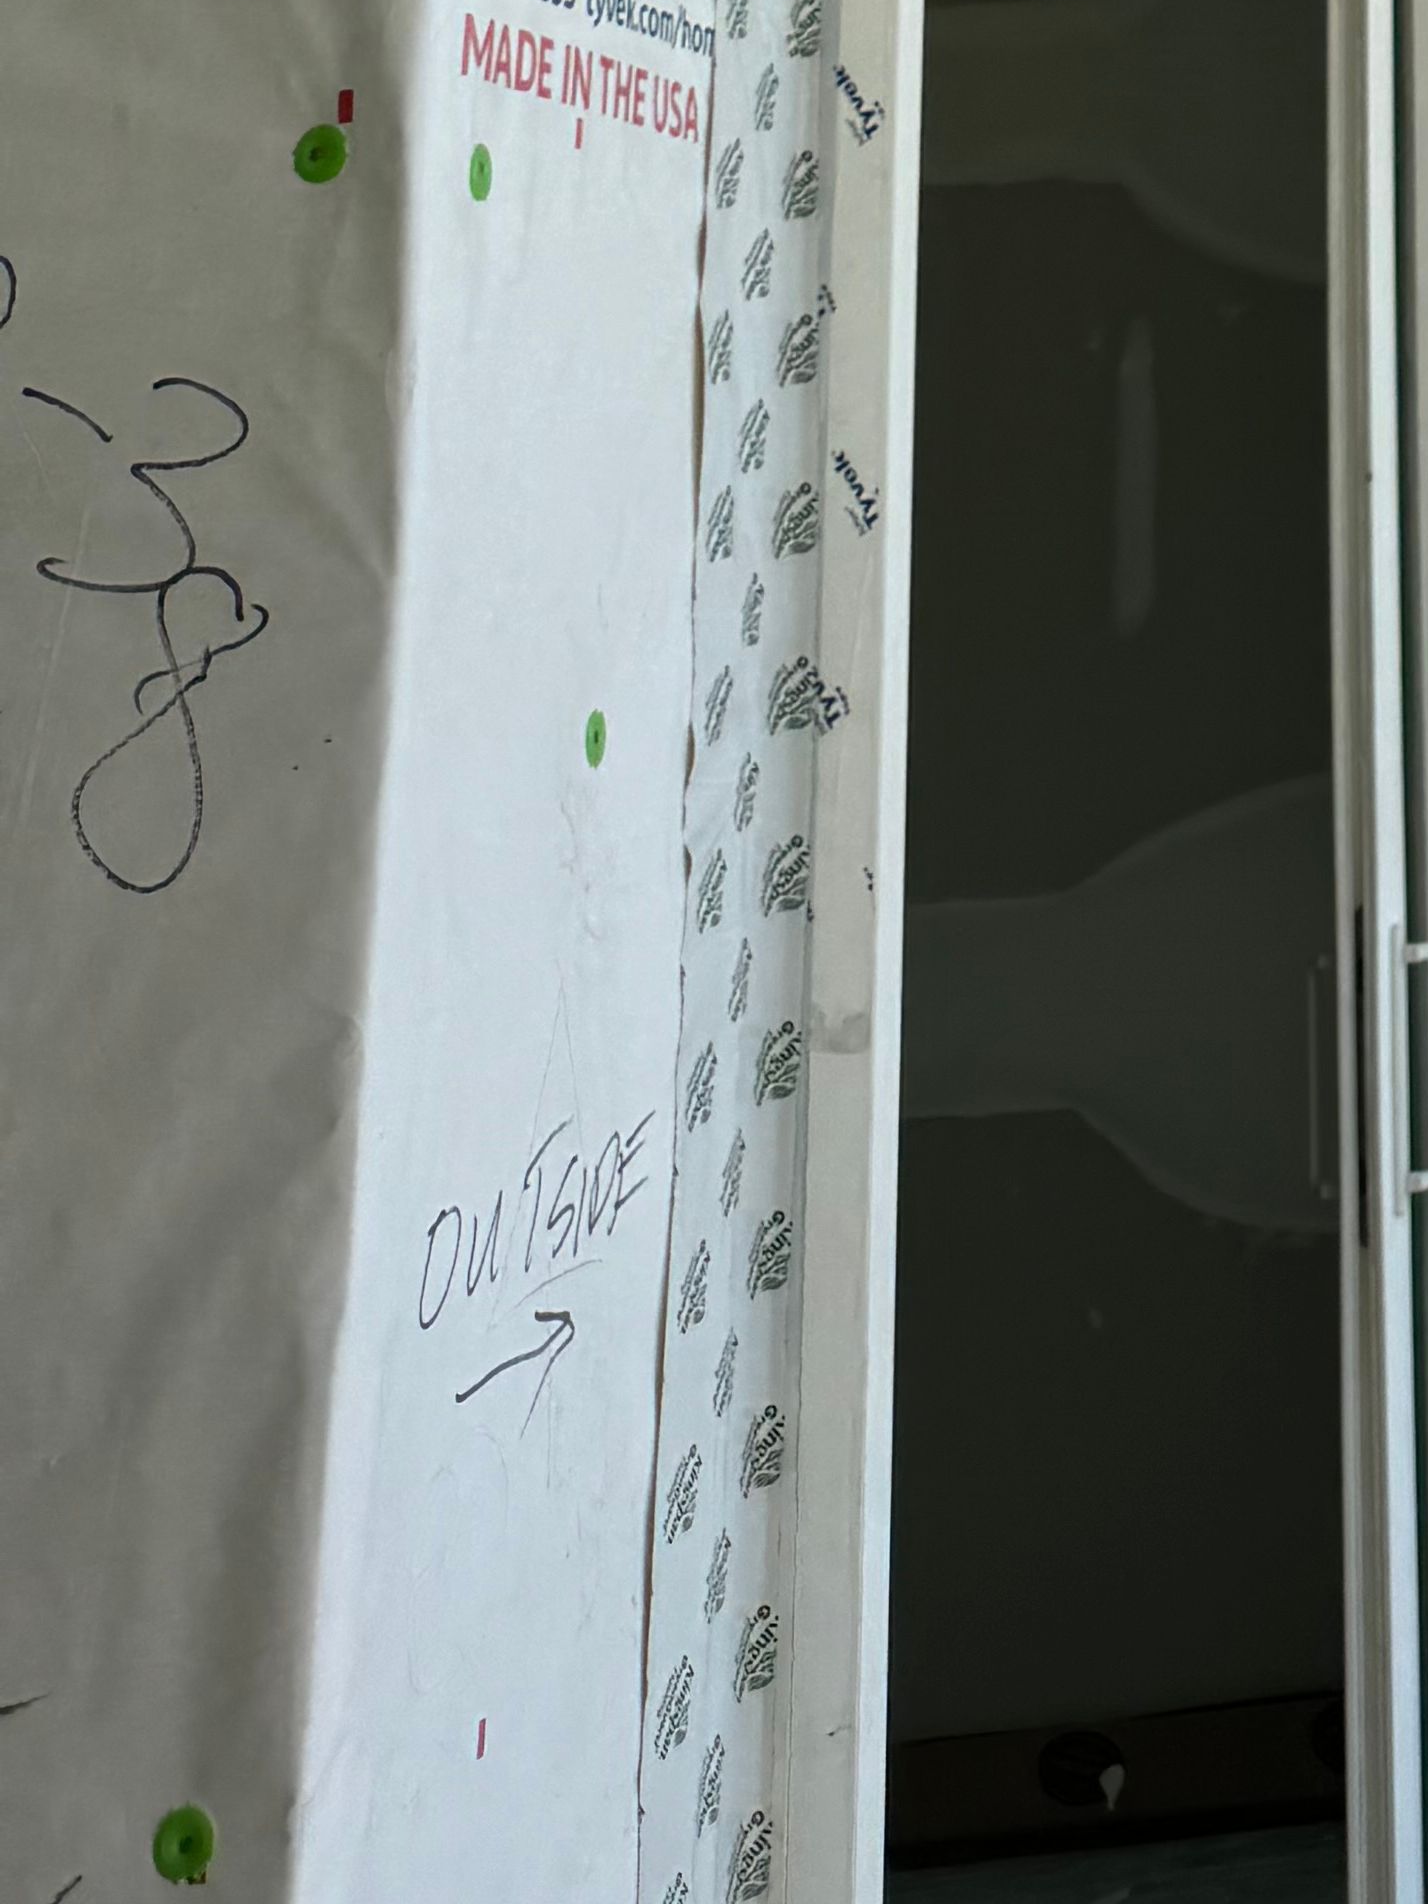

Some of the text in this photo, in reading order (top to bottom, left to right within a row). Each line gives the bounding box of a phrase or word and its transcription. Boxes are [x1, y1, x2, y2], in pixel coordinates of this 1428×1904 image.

[462, 14, 700, 144] MADE IN THE USA
[419, 1109, 657, 1330] OUTSIDE
